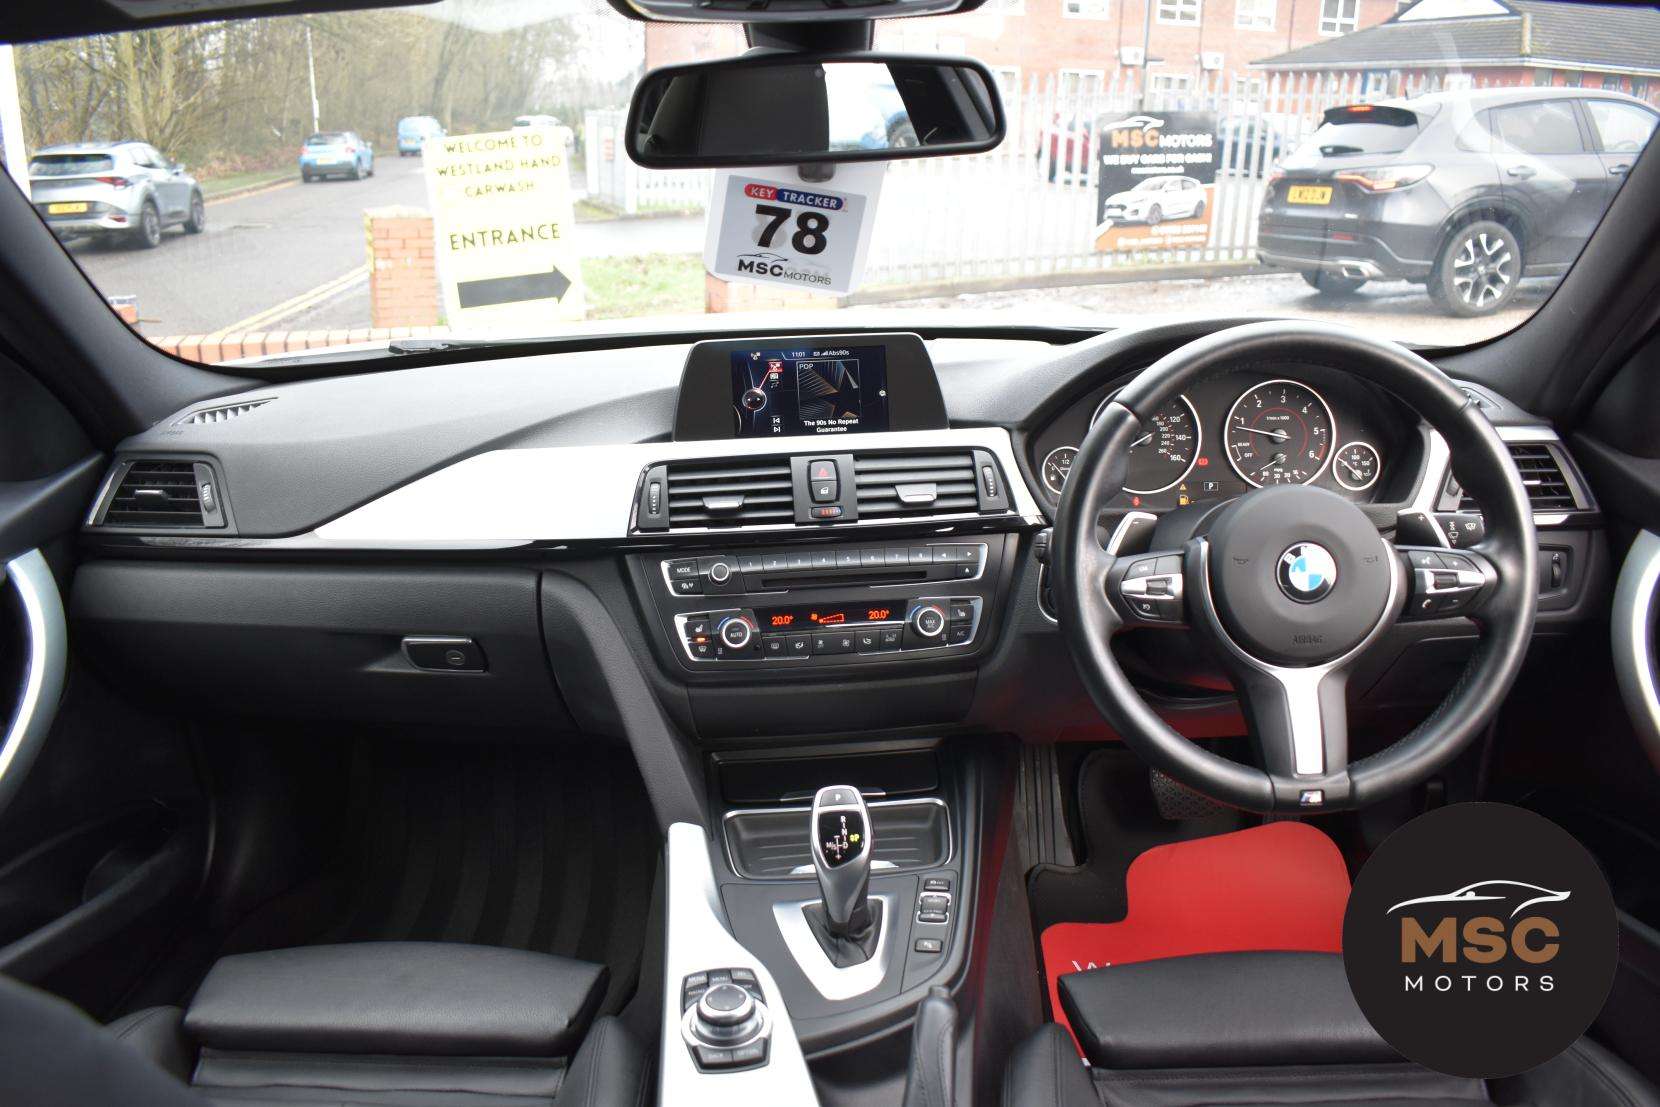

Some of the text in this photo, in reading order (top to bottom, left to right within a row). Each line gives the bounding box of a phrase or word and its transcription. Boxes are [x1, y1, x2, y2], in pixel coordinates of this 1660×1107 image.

[1111, 128, 1159, 148] MSC
[444, 134, 543, 153] WELCOME TO
[436, 155, 561, 177] WESTLAND HAND
[464, 180, 535, 198] CARWASH
[750, 186, 837, 210] KEY TRACKER
[755, 204, 830, 255] 78
[450, 223, 561, 250] ENTRANCE
[737, 259, 832, 286] MSC MOTORS
[1280, 395, 1286, 403] 3
[1256, 400, 1262, 408] 2
[1302, 406, 1308, 414] 4
[816, 419, 827, 427] 90s
[837, 418, 859, 426] Repeat
[816, 426, 848, 434] Guarantee
[1313, 427, 1319, 435] 5
[1309, 450, 1315, 458] 6
[676, 566, 692, 574] MODE
[867, 609, 890, 620] 20.0°
[771, 615, 794, 626] 20.0°
[840, 815, 847, 823] R
[841, 828, 848, 836] N
[842, 841, 849, 849] D
